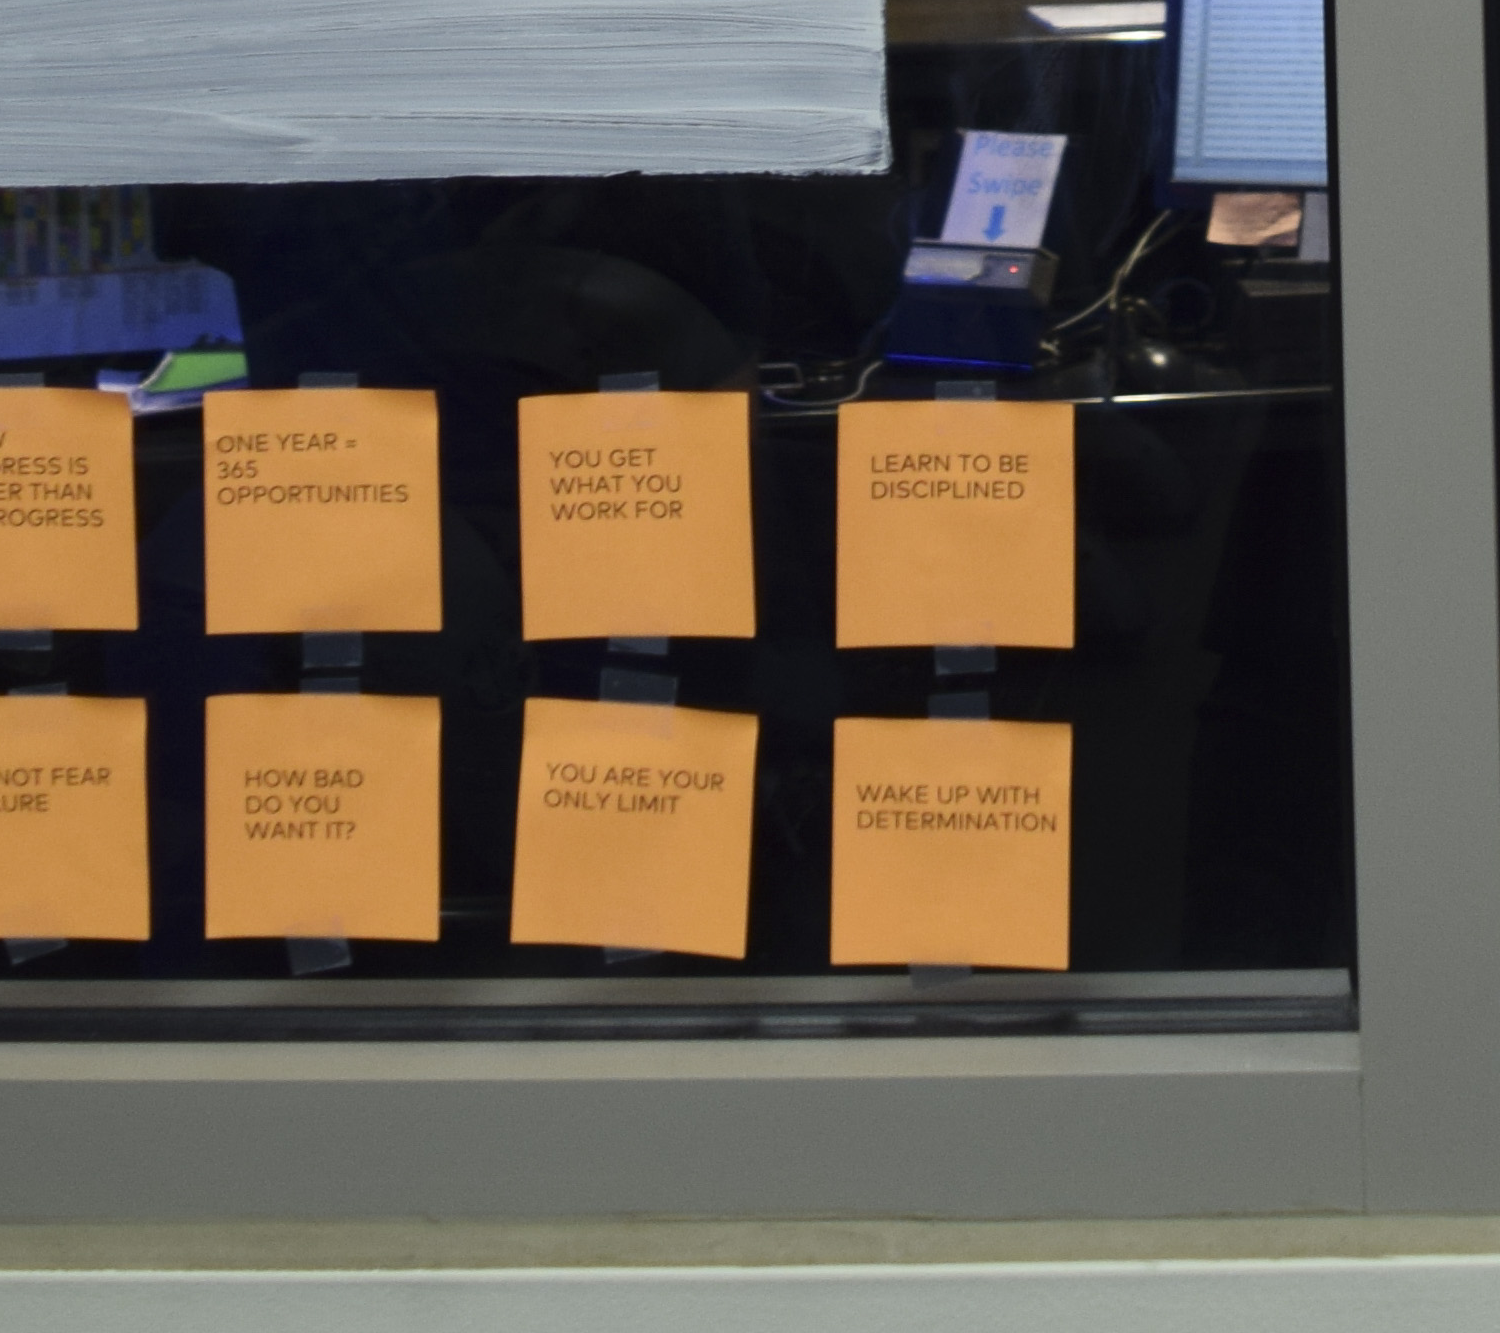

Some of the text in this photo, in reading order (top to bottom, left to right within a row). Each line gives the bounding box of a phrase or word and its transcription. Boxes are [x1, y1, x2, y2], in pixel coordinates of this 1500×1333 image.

[974, 134, 1054, 158] Please
[967, 171, 1043, 200] Swipe
[549, 447, 657, 470] YOU GET
[870, 453, 1029, 475] LEARN TO BE
[549, 473, 682, 496] WHAT YOU
[870, 479, 1026, 501] DISCIPLINED
[550, 499, 684, 522] WORK FOR
[546, 762, 725, 792] YOU ARE YOUR
[543, 788, 681, 814] ONLY LIMIT
[855, 784, 1041, 806] WAKE UP WITH
[856, 809, 1057, 833] DETERMINATION
